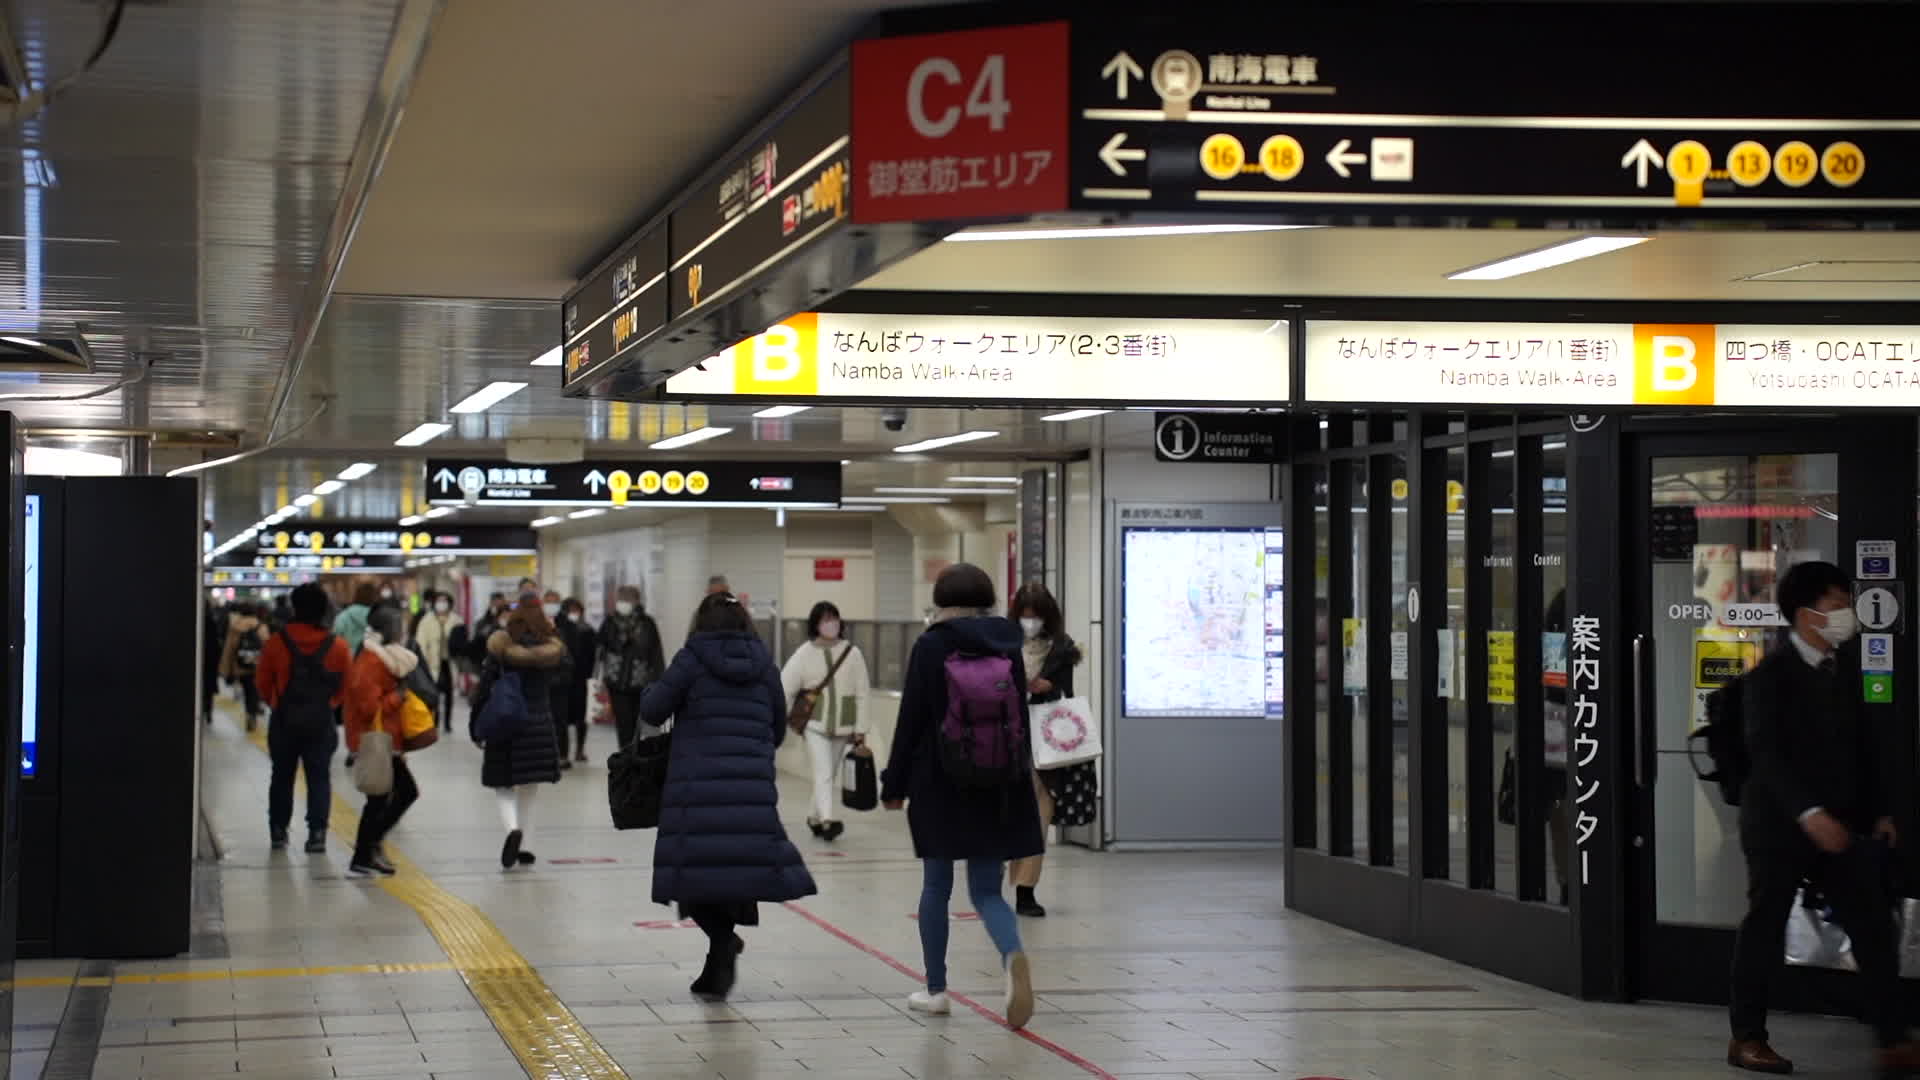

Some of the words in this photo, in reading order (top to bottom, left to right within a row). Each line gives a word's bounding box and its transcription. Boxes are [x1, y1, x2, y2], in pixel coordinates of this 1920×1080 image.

[906, 53, 1011, 138] C4
[1210, 146, 1235, 168] 16
[1270, 147, 1295, 168] 18
[1736, 154, 1762, 174] 13
[1783, 154, 1809, 174] 19
[1830, 153, 1859, 175] 20
[868, 149, 1053, 197] 御堂筋エリア
[752, 324, 802, 382] B
[1652, 335, 1698, 392] B
[832, 362, 903, 381] Namba
[1441, 369, 1510, 386] Namba
[1203, 431, 1272, 443] Information
[1203, 444, 1251, 457] Counter
[1668, 604, 1713, 620] OPEN
[1571, 614, 1601, 885] 案内カウンター
